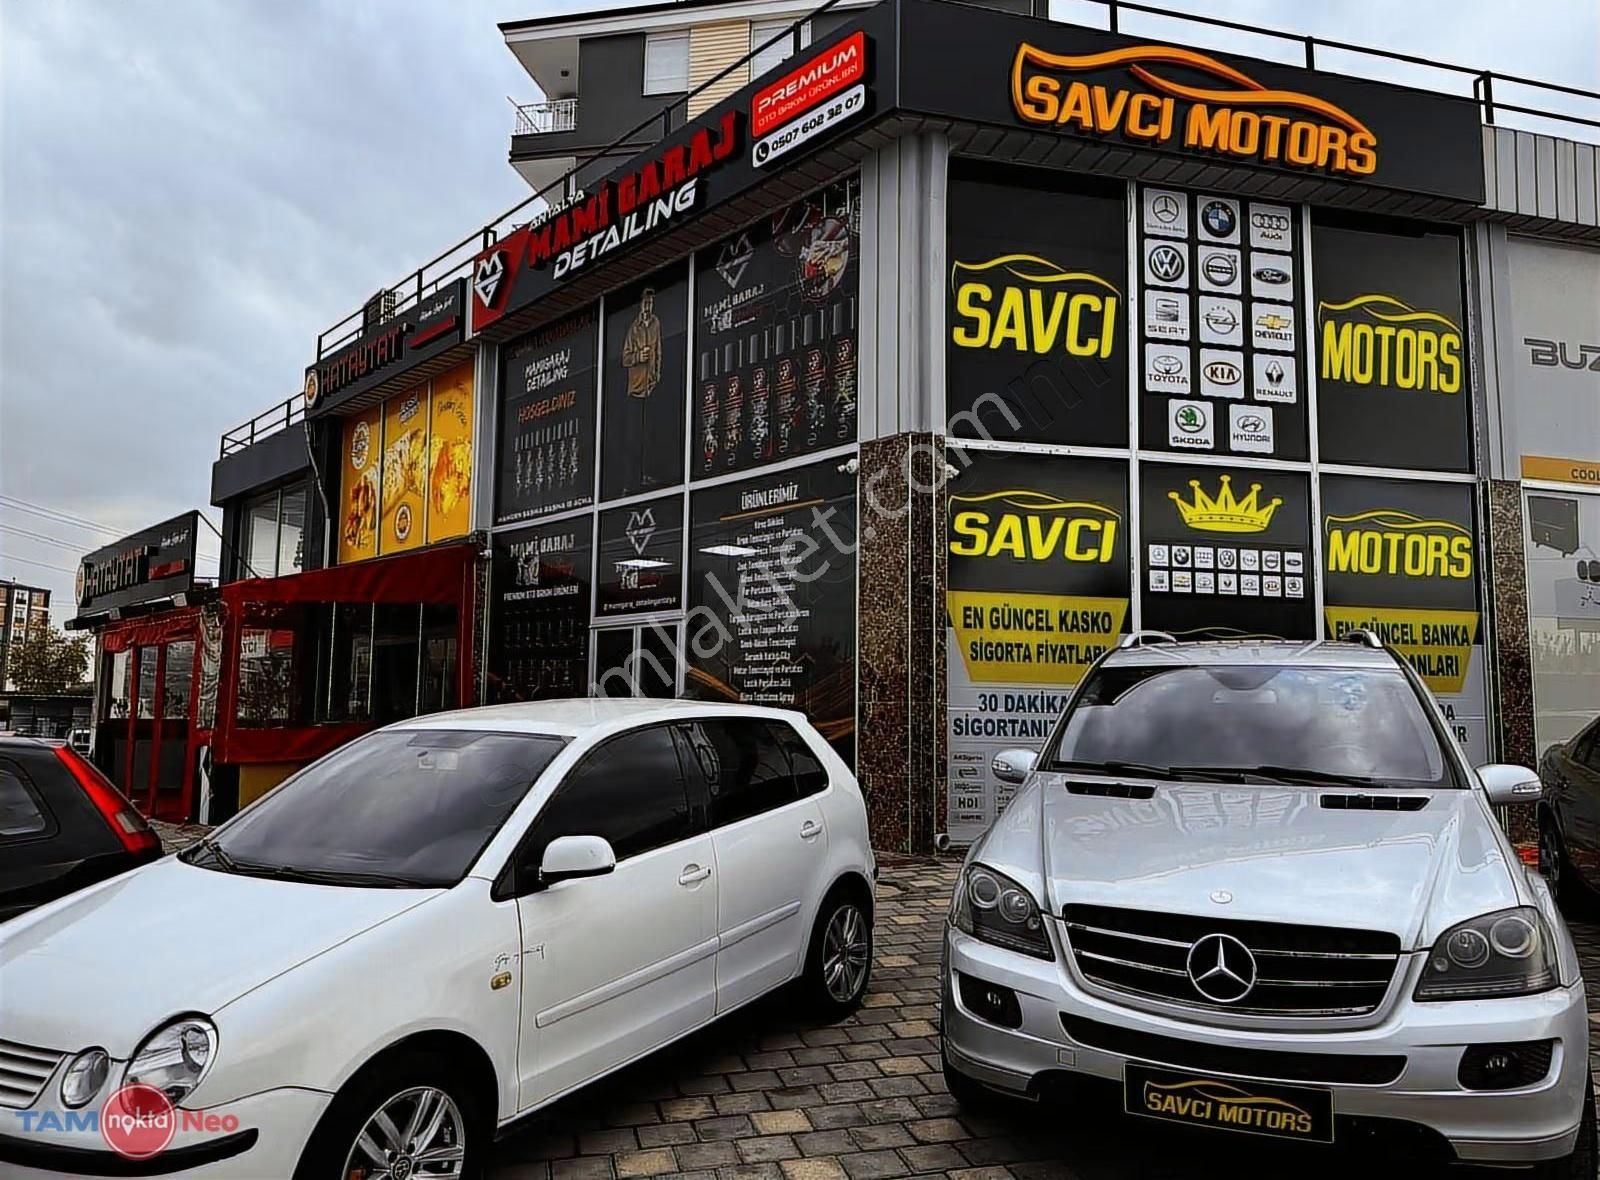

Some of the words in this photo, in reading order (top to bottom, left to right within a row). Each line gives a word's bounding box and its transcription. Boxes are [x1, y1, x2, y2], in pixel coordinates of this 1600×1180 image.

[758, 44, 857, 113] PREMIUM
[771, 127, 800, 151] 0507
[801, 113, 824, 134] 602
[844, 92, 862, 110] 07
[1024, 75, 1175, 143] SAVCI
[1184, 104, 1378, 175] MOTORS
[618, 108, 737, 218] GARAJ
[553, 177, 698, 280] DETAILING
[952, 282, 1118, 359] SAVCI
[1147, 325, 1187, 335] SEAT
[1209, 366, 1236, 380] KIA
[1321, 319, 1462, 395] MOTORS
[1148, 374, 1188, 384] TOYOTA
[1256, 388, 1293, 398] RENAULT
[741, 481, 800, 510] ÜRÜNLERİMİZ
[950, 511, 1117, 563] SAVCI
[1328, 529, 1473, 579] MOTORS
[962, 605, 984, 630] EN
[991, 602, 1055, 633] GÜNCEL
[1058, 610, 1113, 634] KASKO
[1421, 623, 1471, 646] BANKA
[970, 638, 1033, 664] SİGORTA
[1036, 640, 1108, 666] FİYATLAR
[978, 693, 999, 713] 30
[958, 797, 978, 809] HDI
[1147, 1092, 1212, 1119] SAVCI
[1218, 1104, 1313, 1133] MOTORS
